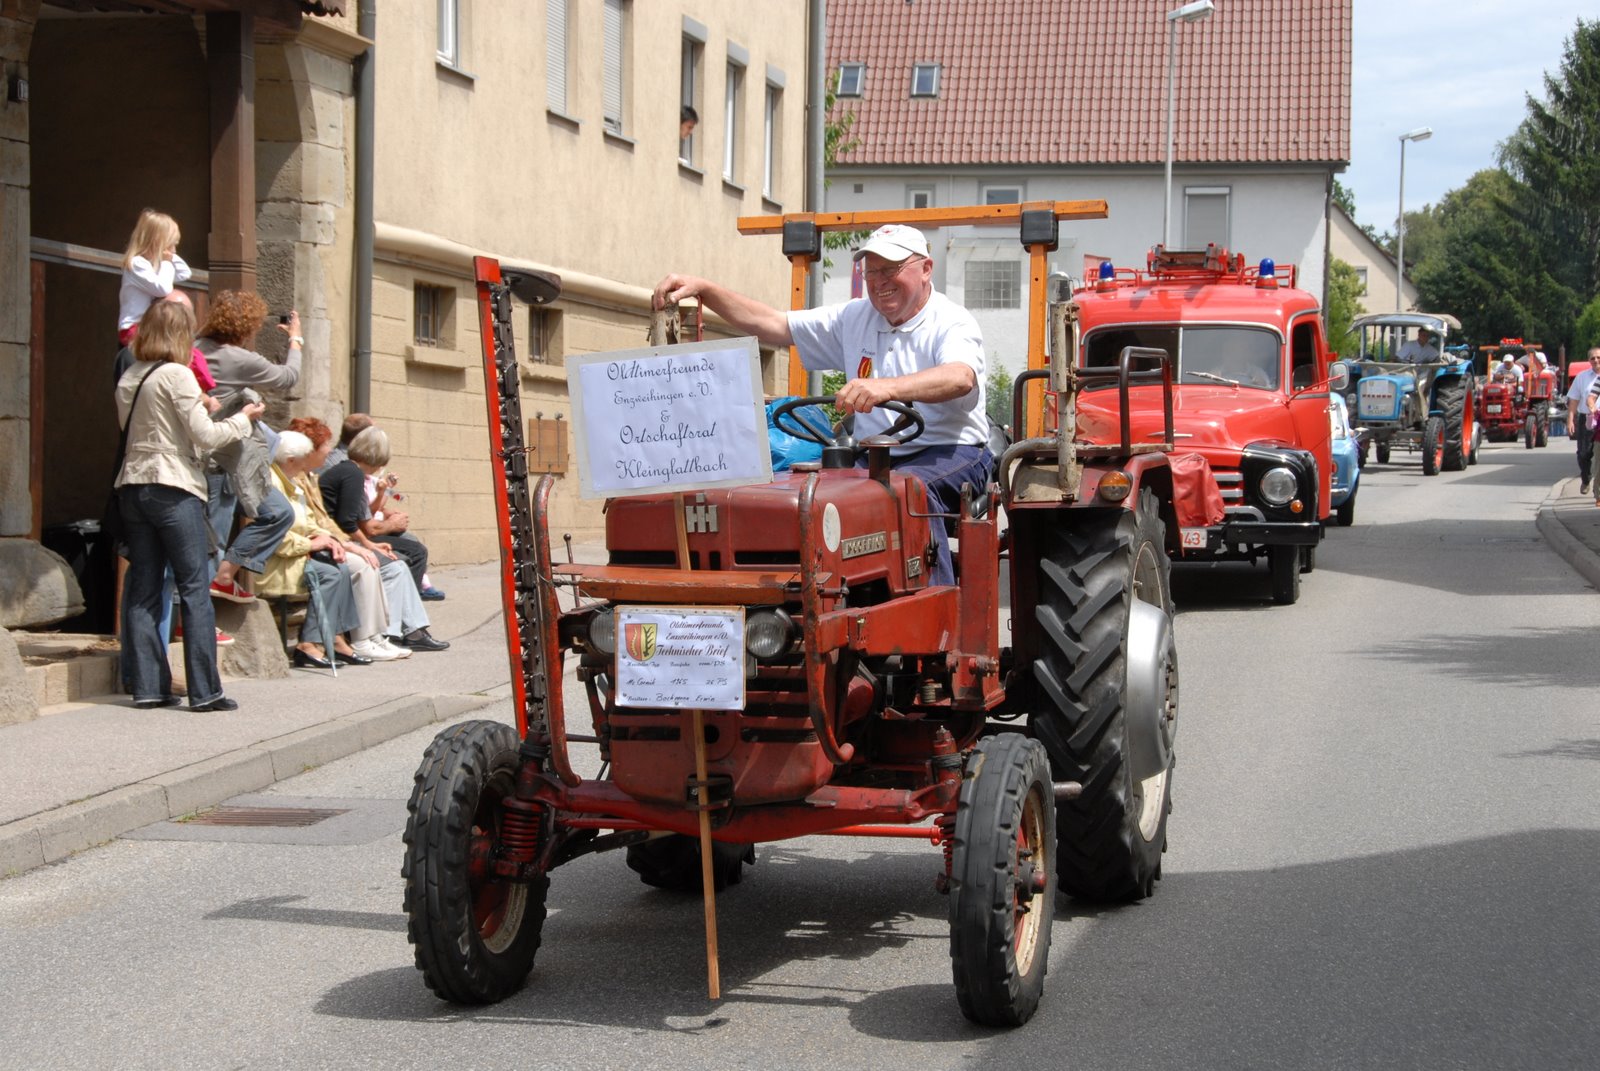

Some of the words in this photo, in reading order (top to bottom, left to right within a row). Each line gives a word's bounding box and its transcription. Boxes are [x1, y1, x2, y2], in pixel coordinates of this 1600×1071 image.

[606, 357, 715, 383] Oldtimerfreunde
[614, 389, 684, 409] Enzweihingen
[660, 409, 671, 423] &
[619, 421, 718, 448] Ortschaftsrat
[615, 452, 728, 483] Kleinglattbach
[1181, 532, 1201, 545] 43
[669, 620, 725, 630] Oldtimerfreunde
[665, 632, 713, 642] Enzweihingen
[657, 645, 703, 656] Technischer
[704, 644, 730, 658] Brief
